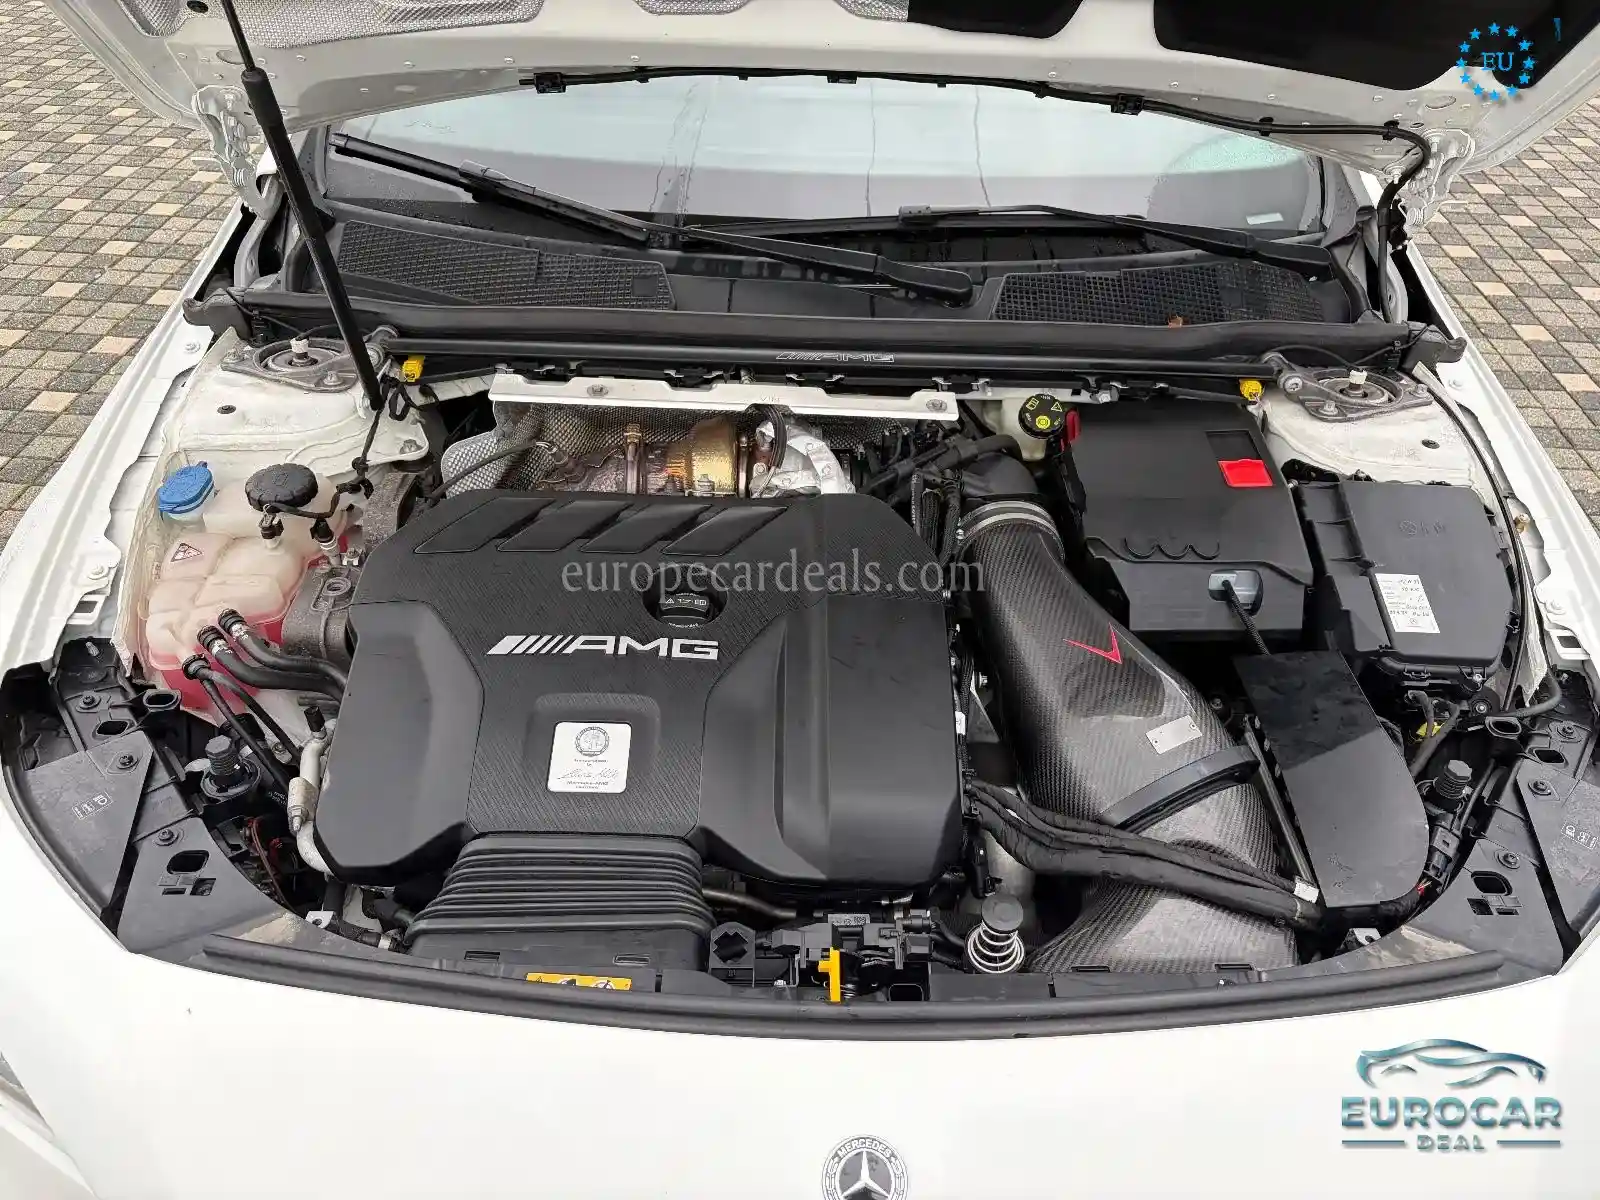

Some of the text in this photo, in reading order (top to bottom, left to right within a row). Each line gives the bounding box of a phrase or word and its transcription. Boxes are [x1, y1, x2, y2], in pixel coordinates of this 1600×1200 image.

[816, 351, 895, 363] AMG
[561, 634, 720, 661] AMG
[837, 1137, 893, 1158] MERCEDES
